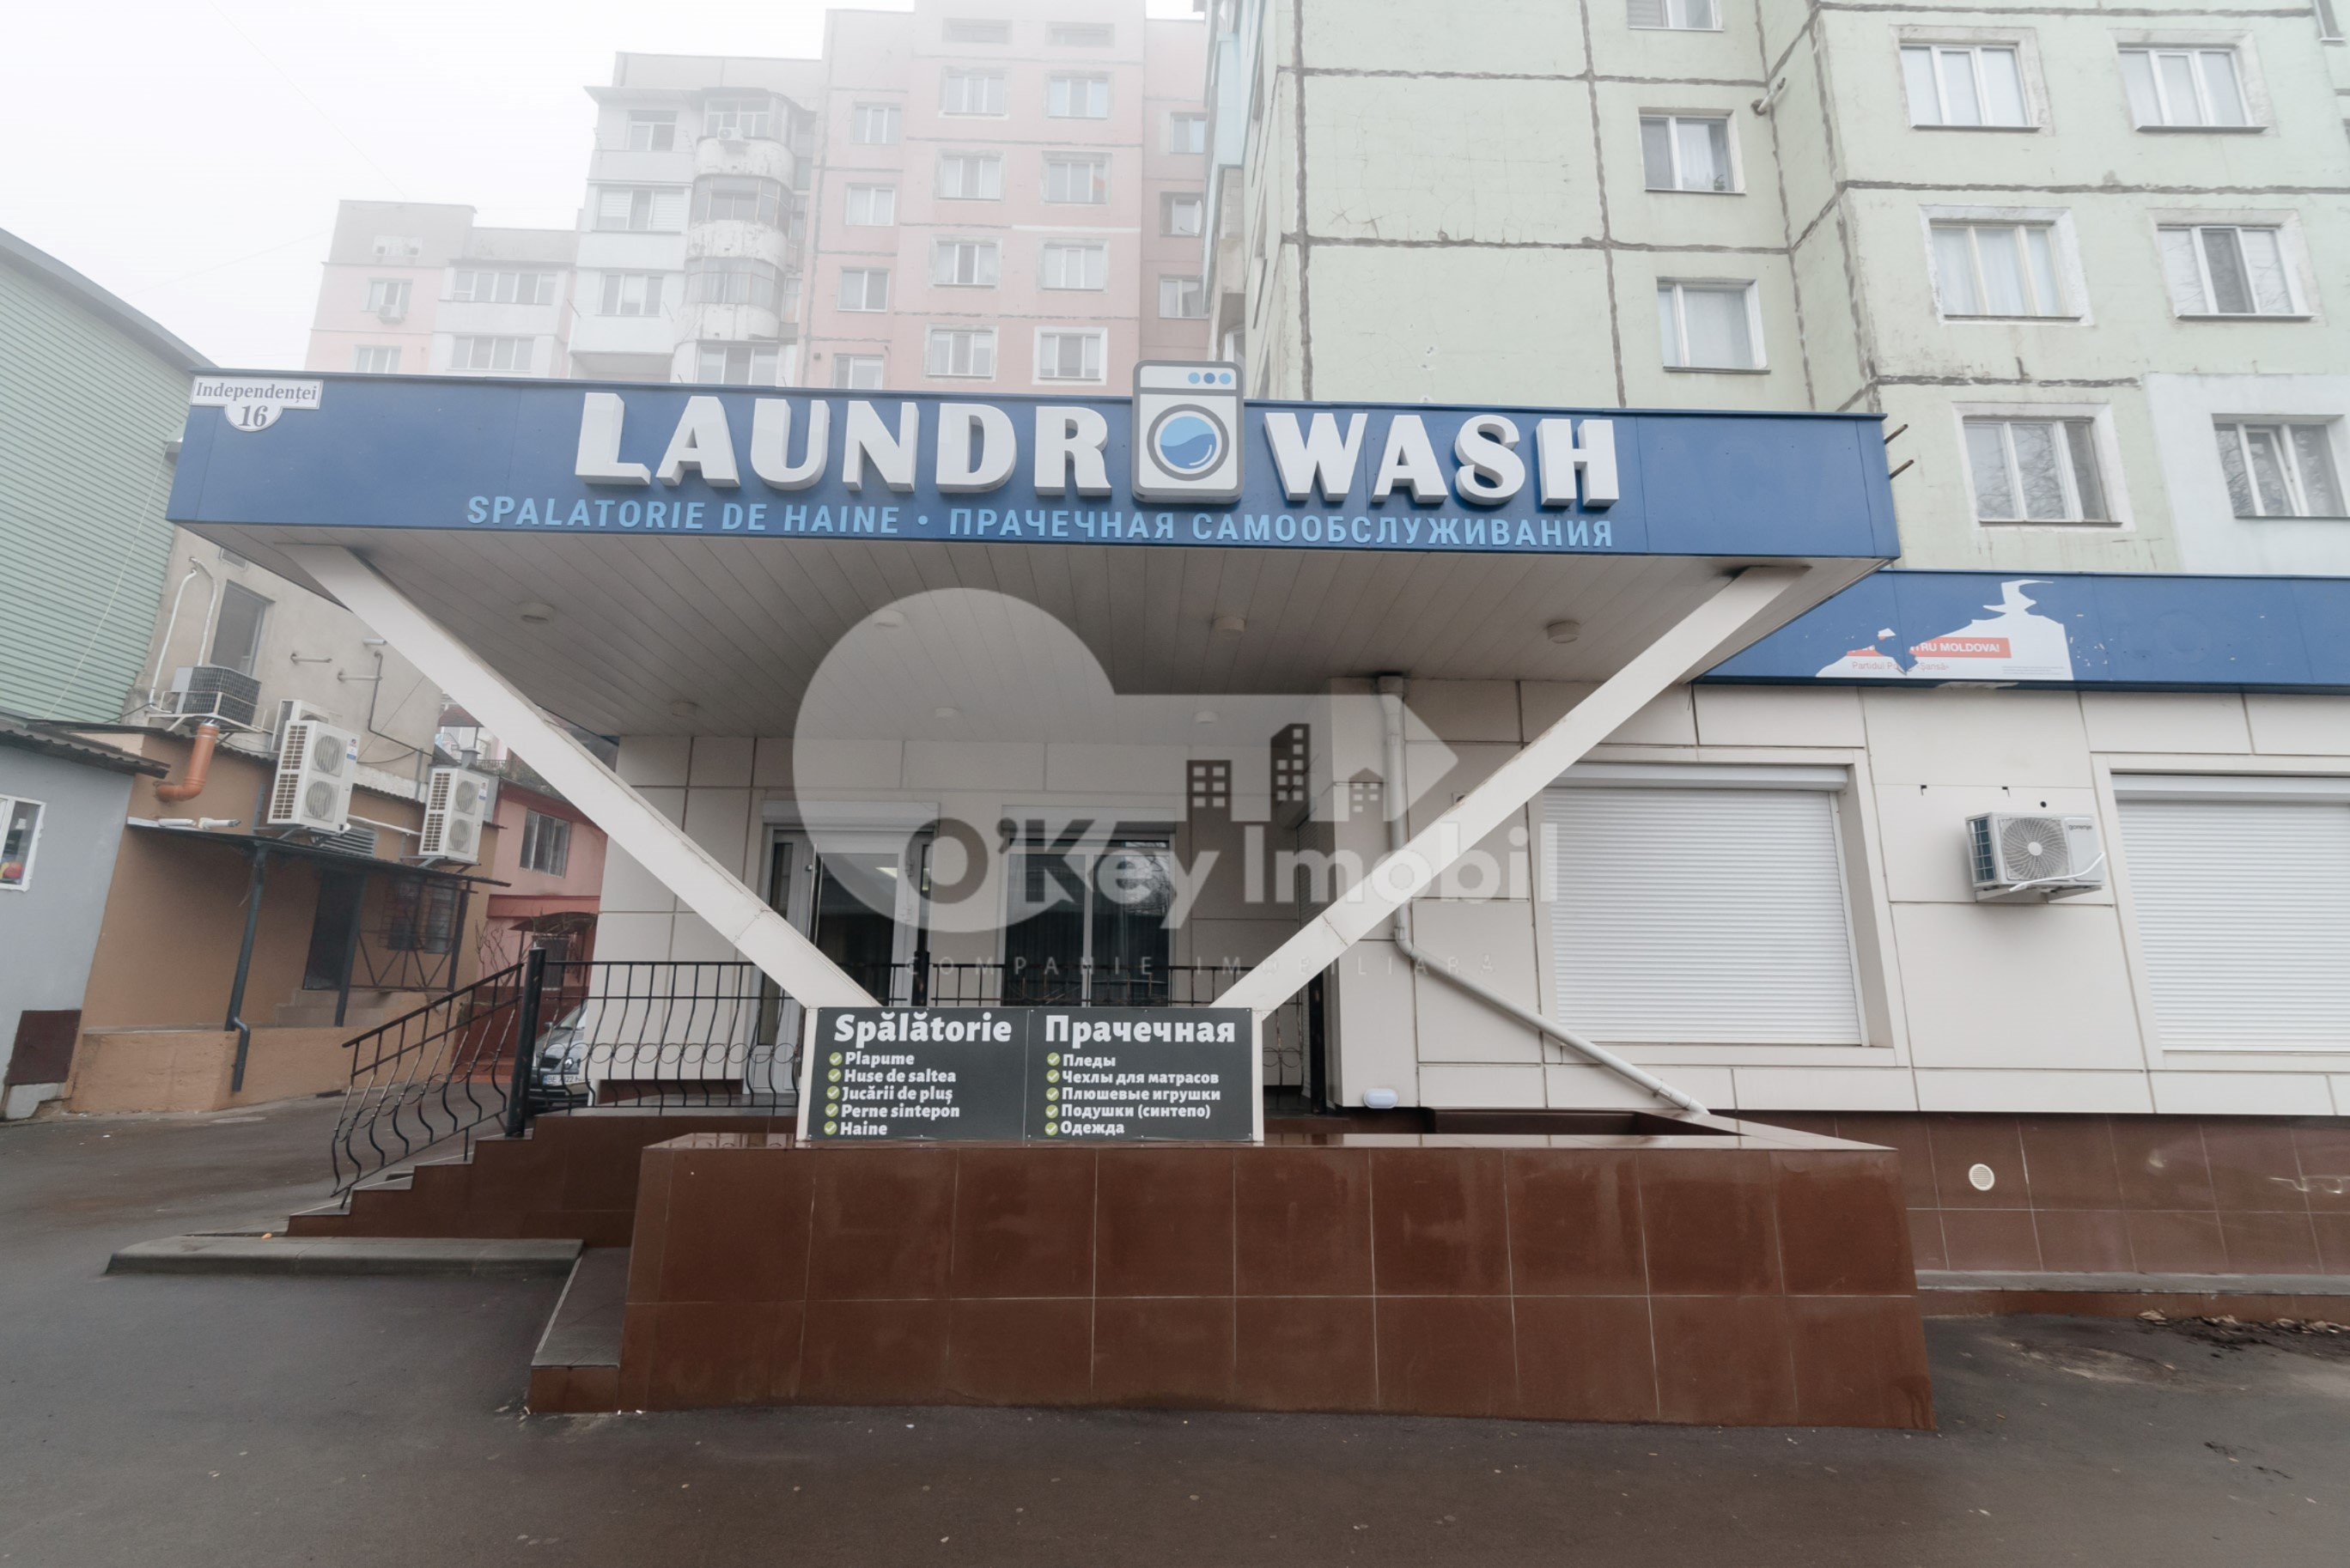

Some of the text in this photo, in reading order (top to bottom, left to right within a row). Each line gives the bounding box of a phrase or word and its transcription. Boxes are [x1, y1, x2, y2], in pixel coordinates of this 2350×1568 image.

[196, 382, 318, 403] Independenței
[238, 405, 269, 428] 16
[1263, 411, 1620, 508] WASH
[466, 495, 900, 534] SPALATORIE DE HAINE
[948, 508, 1613, 548] ПРАЧЕЧНАЯ САМООБСЛУЖИВАНИЯ
[1940, 642, 2000, 653] MOLDOVA!
[1852, 661, 1885, 670] Partidul
[833, 1011, 1013, 1049] Spălătorie
[1045, 1014, 1236, 1049] Прачечная
[844, 1050, 916, 1068] Plapume
[1062, 1053, 1117, 1069] Пледы
[843, 1068, 957, 1083] Huse de saltea
[1062, 1070, 1220, 1086] Чехлы для матрасов
[841, 1085, 953, 1105] Jucării de pluș
[1062, 1087, 1221, 1103] Плюшевые игрушки
[841, 1103, 960, 1121] Perne sintepon
[1061, 1103, 1211, 1120] Подушки (синтепо)
[840, 1121, 888, 1136] Haine
[1060, 1121, 1125, 1136] Одежда
